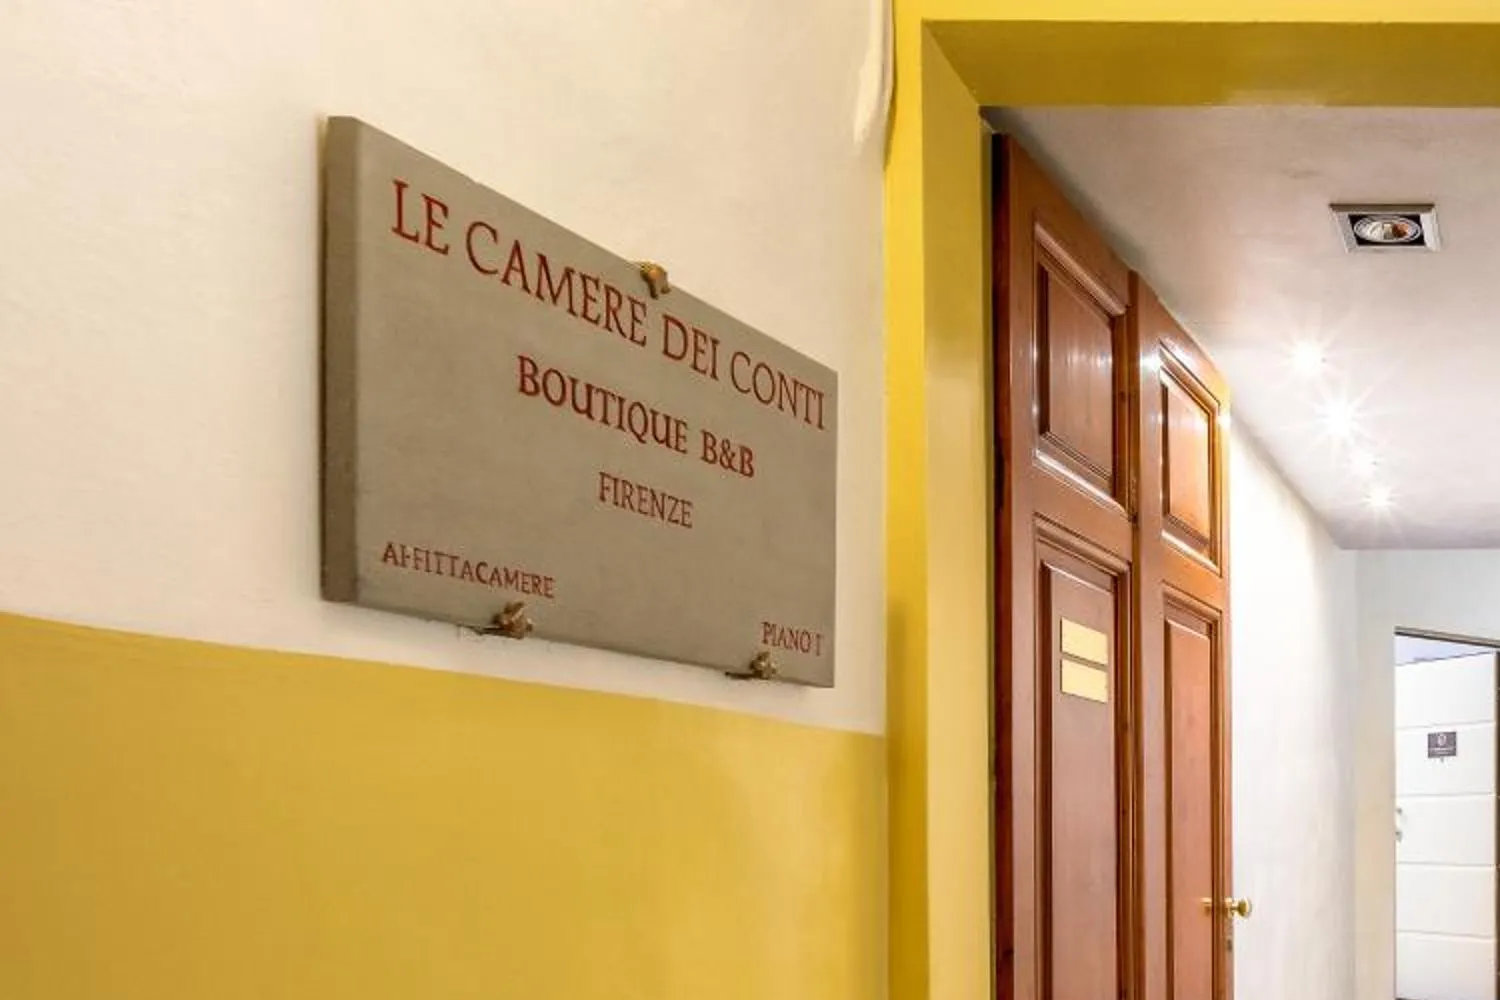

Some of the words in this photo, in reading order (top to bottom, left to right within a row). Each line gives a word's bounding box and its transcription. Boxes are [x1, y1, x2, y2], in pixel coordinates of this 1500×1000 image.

[392, 179, 449, 256] LE
[465, 221, 648, 348] CAMERE
[662, 313, 720, 380] DEI
[730, 351, 825, 430] CONTI
[517, 355, 689, 455] BOUTIQUE
[700, 430, 755, 479] B&B
[599, 472, 694, 529] FIRENZE
[383, 542, 556, 598] AFFITTACAMERE
[761, 622, 812, 654] PIANO
